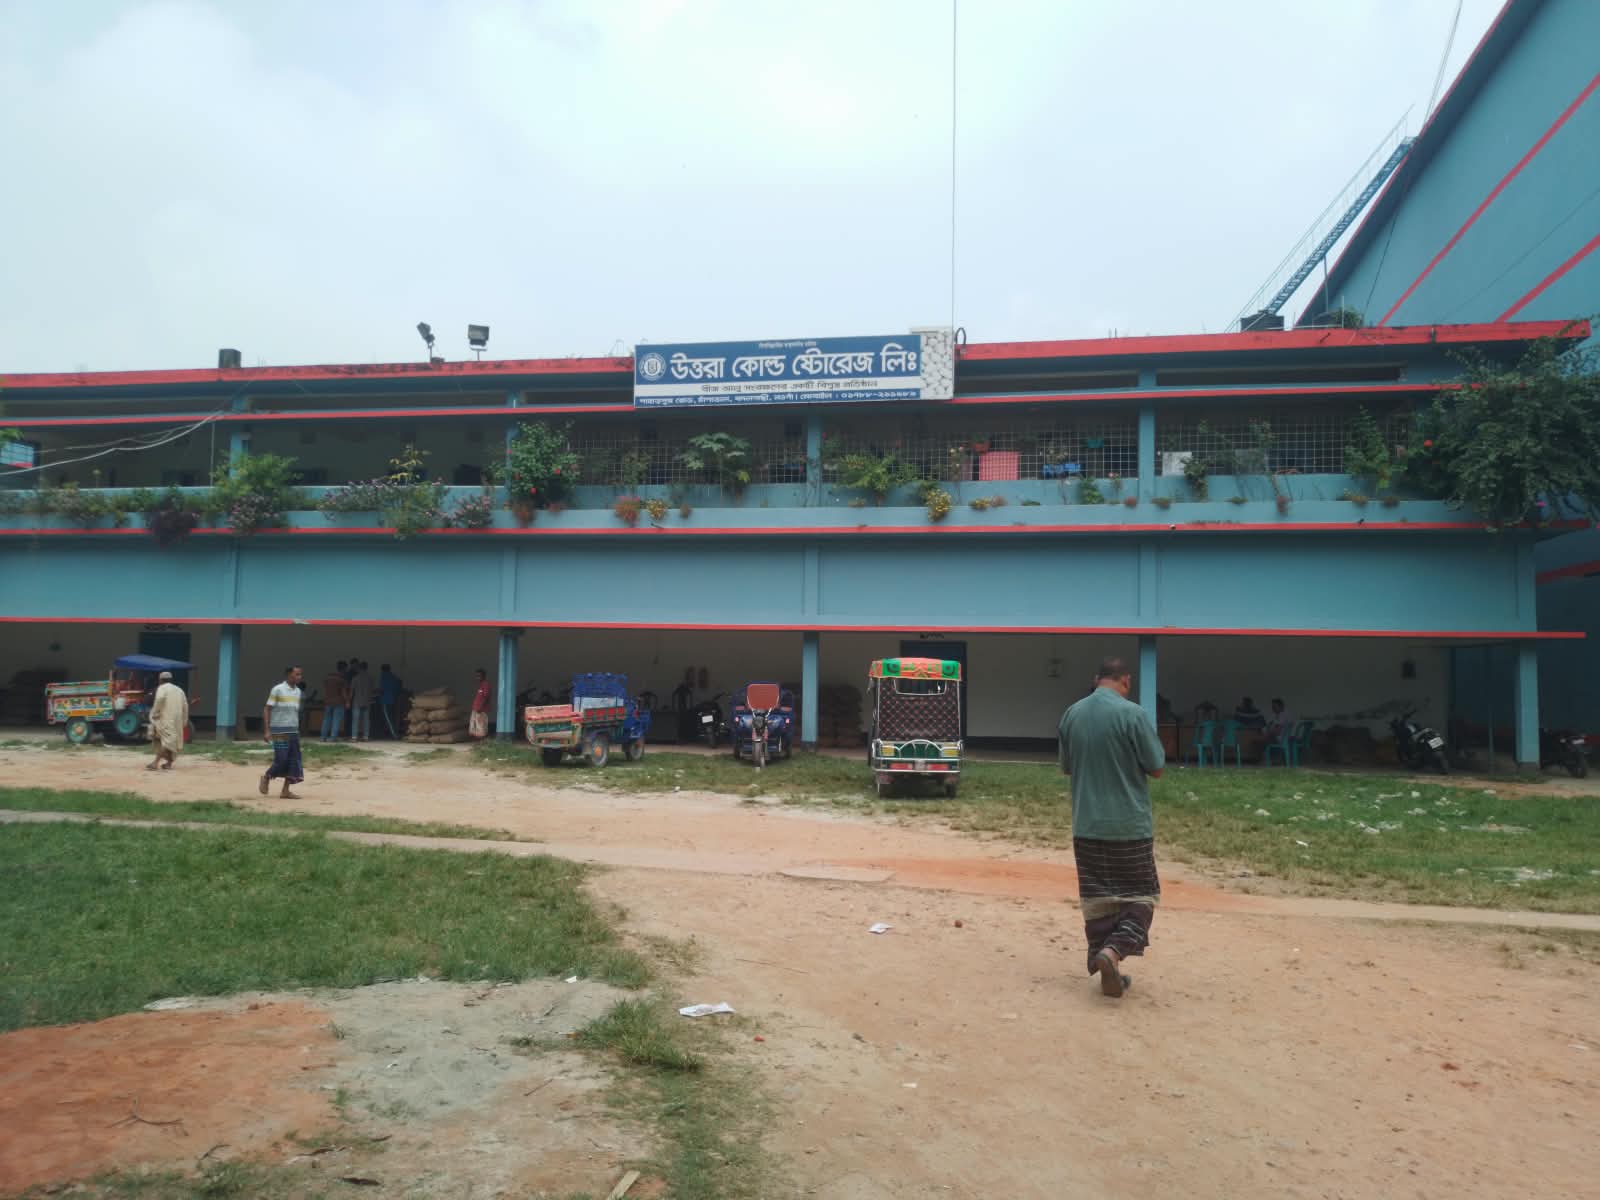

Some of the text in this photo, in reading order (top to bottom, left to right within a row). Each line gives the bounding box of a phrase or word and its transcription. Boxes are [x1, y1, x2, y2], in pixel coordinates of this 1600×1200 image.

[670, 352, 727, 380] উত্তরা
[732, 353, 787, 378] কোল্ড
[791, 348, 875, 376] ষ্টোরেজ
[880, 343, 918, 373] লিঃ
